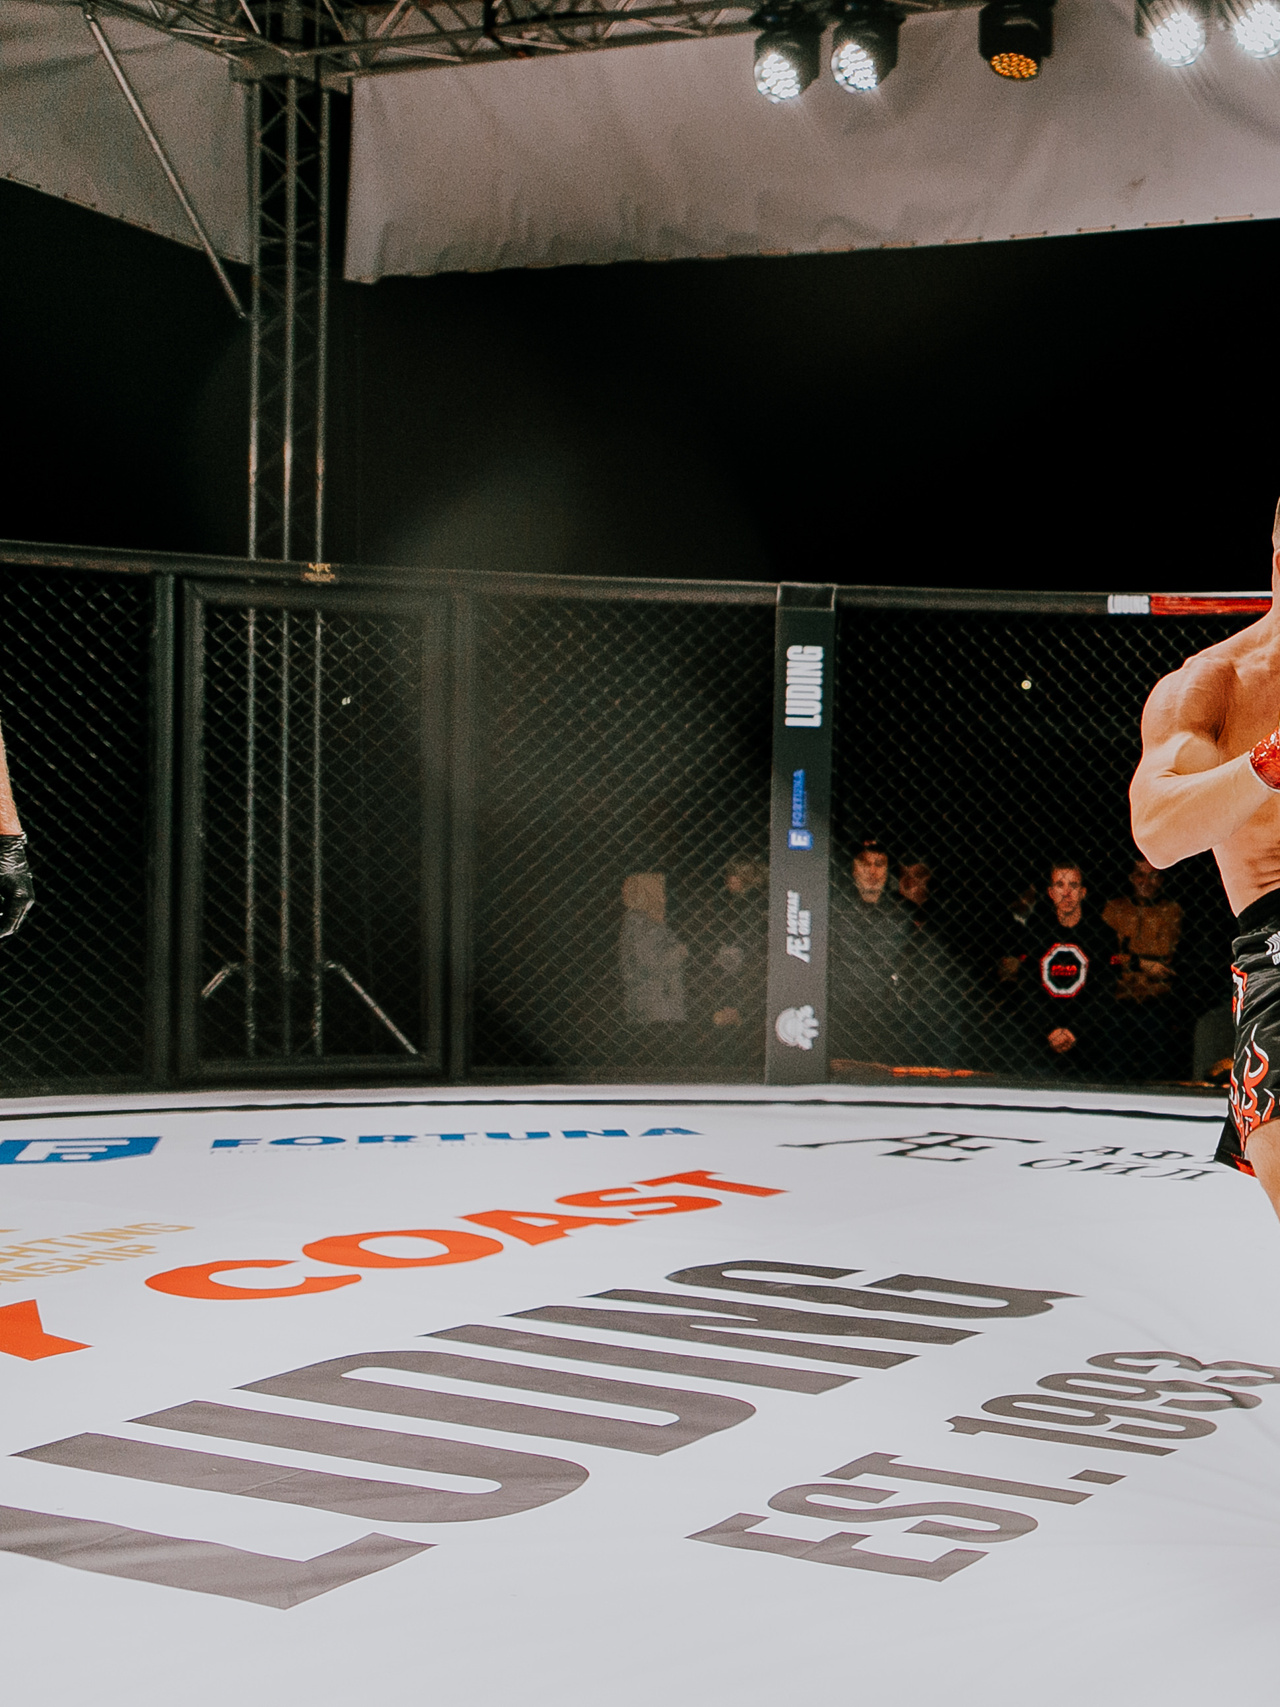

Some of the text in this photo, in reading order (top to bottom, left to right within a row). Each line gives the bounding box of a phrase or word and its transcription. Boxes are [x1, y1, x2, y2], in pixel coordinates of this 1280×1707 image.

[785, 645, 823, 726] LUDING
[211, 1127, 705, 1149] FORTUNA
[145, 1170, 791, 1300] COAST
[0, 1260, 1086, 1610] LUDING
